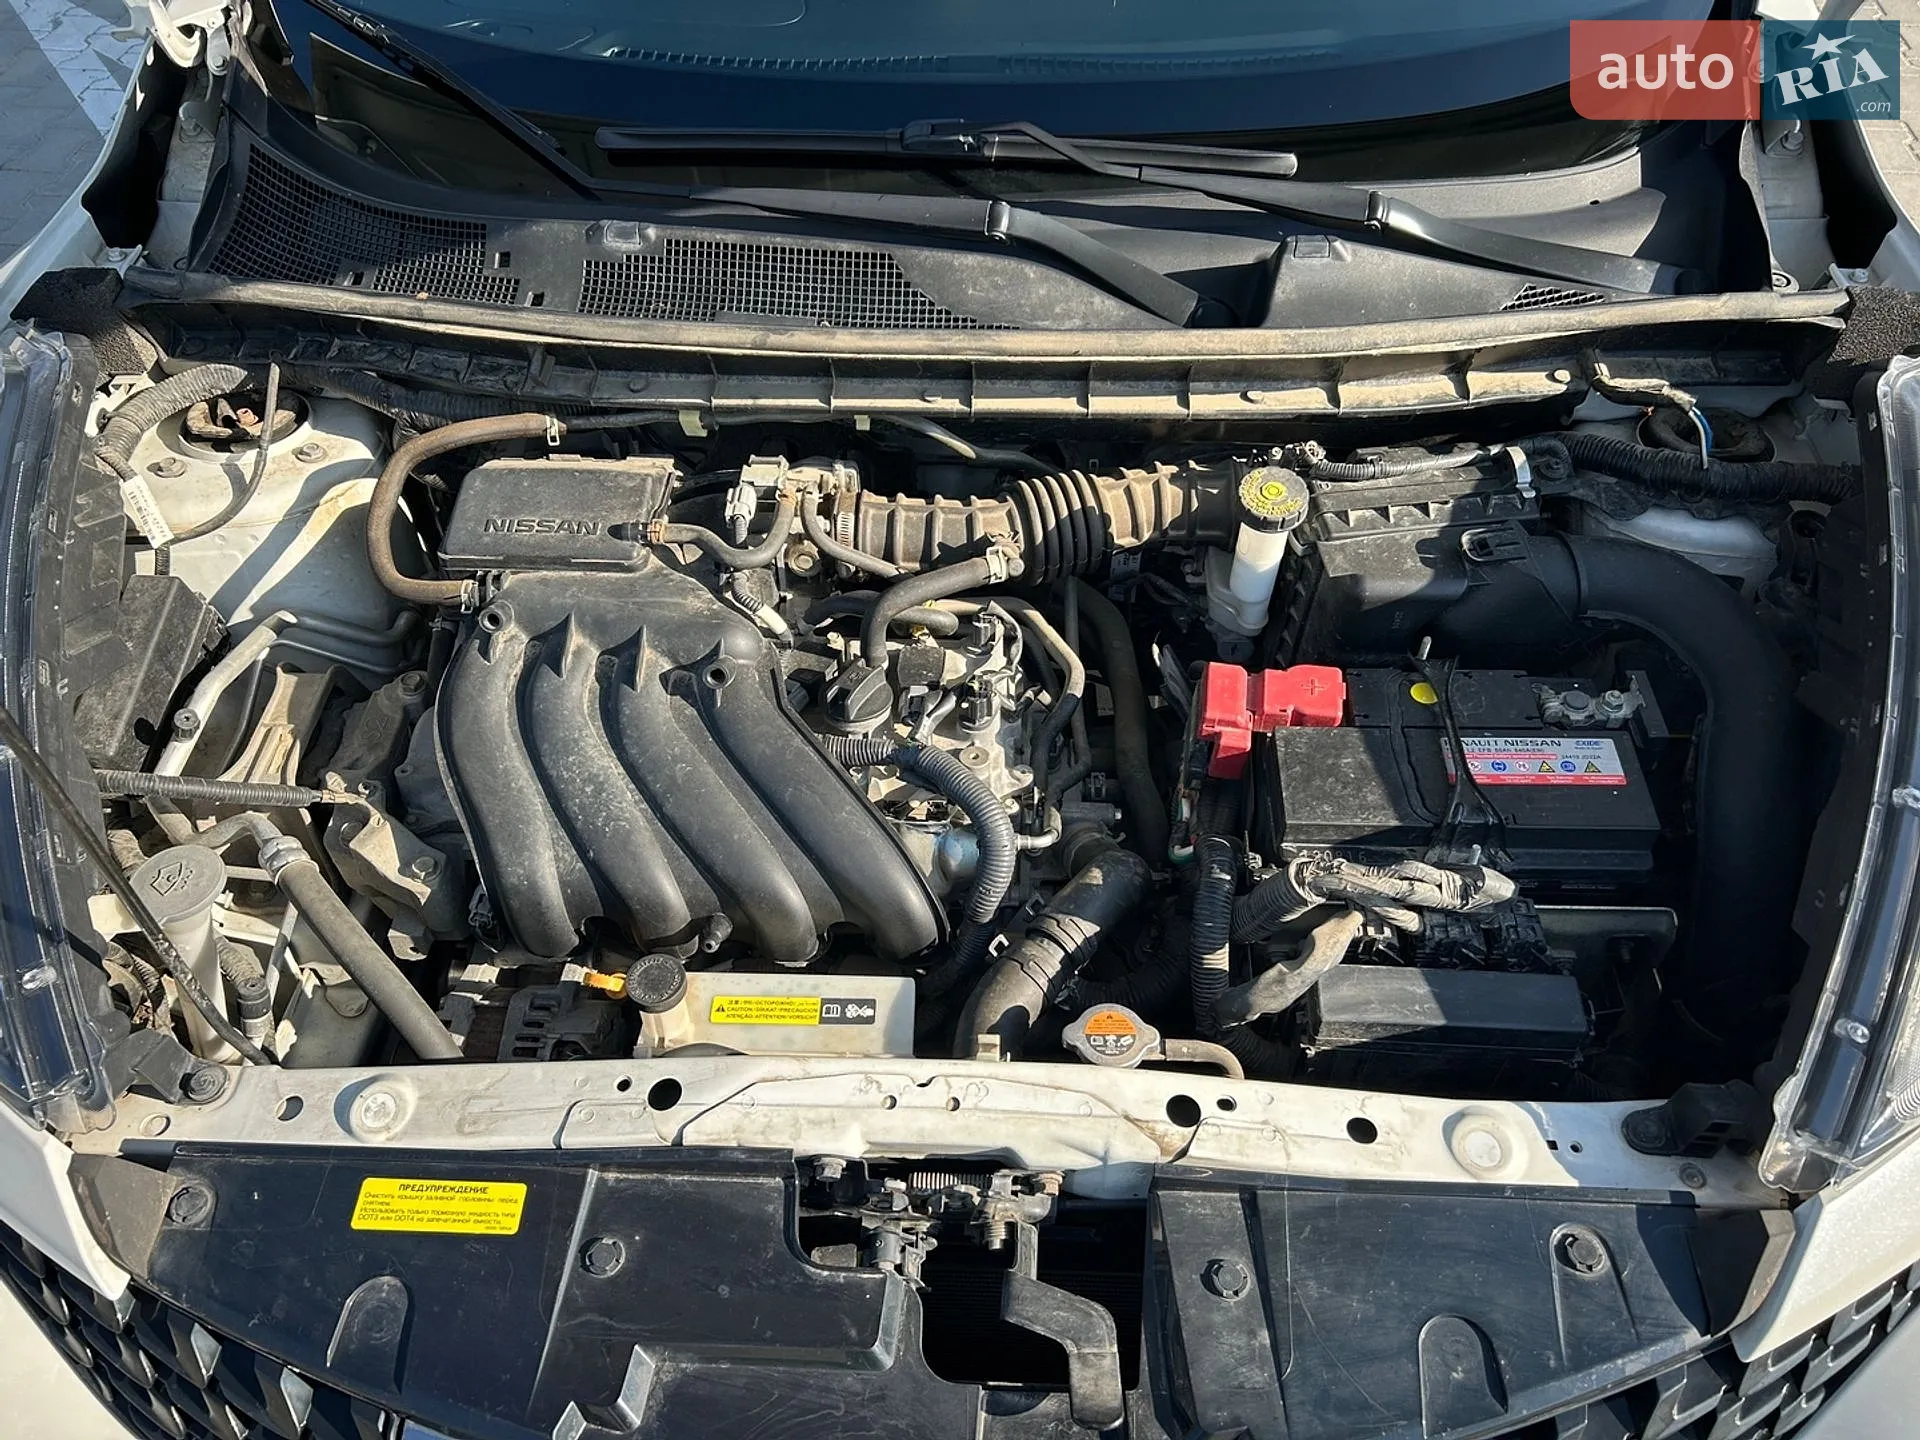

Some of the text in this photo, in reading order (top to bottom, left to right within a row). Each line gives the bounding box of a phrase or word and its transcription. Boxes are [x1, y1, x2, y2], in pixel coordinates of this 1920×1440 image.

[483, 518, 600, 536] NISSAN
[1503, 739, 1562, 748] NISSAN
[398, 1184, 490, 1195] ПРЕДУПРЕЖДЕНИЕ
